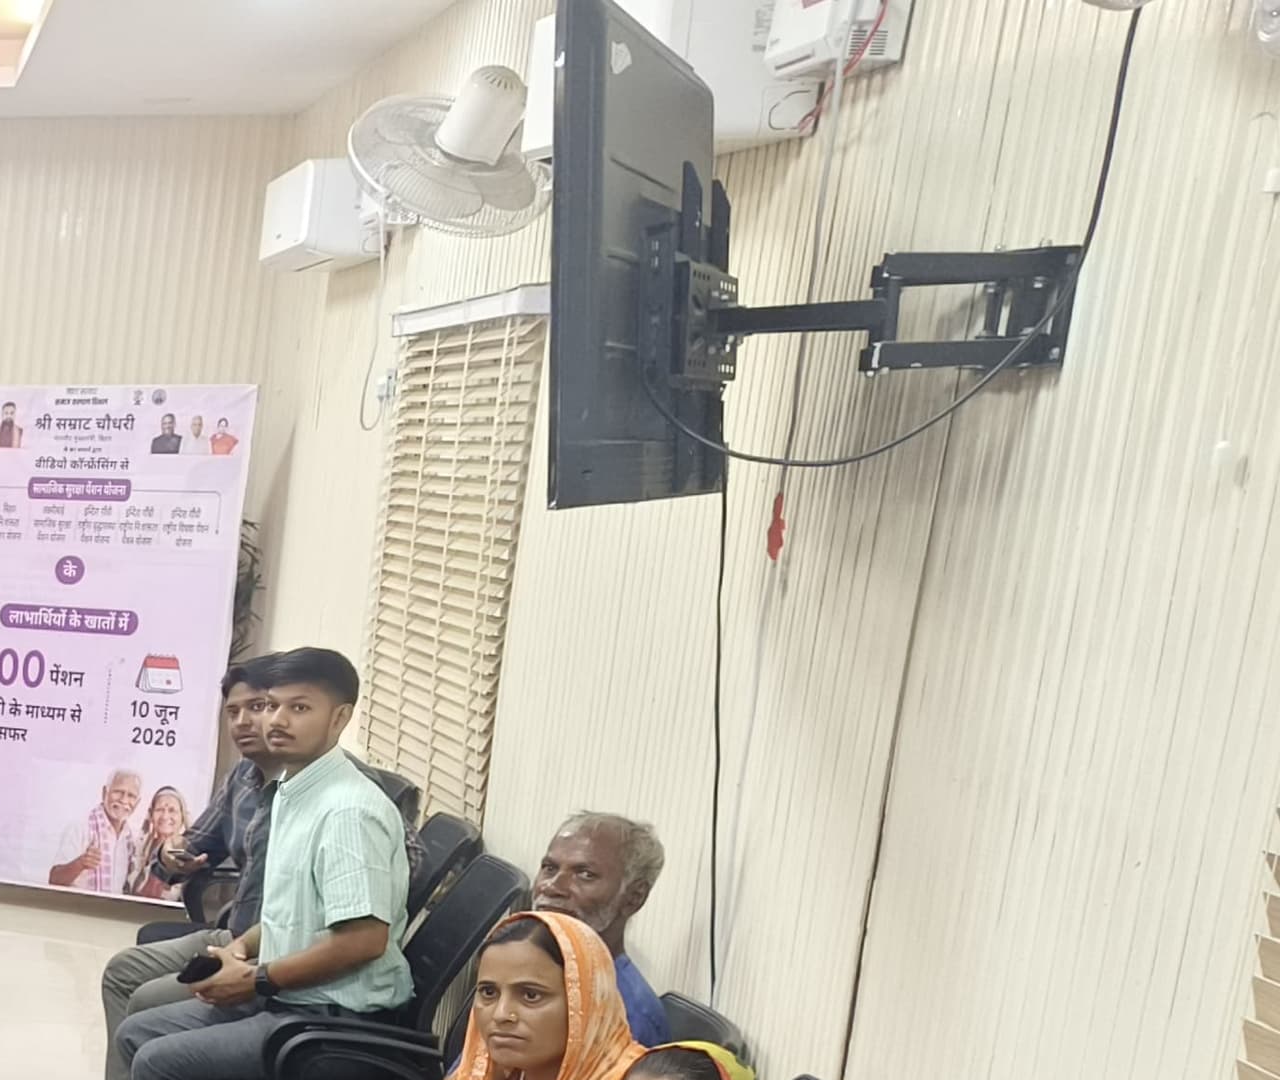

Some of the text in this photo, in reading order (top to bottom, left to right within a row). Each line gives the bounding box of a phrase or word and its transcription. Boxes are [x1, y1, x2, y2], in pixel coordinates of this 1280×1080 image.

[35, 413, 136, 431] श्री सम्राट चौधरी
[35, 456, 67, 469] वीडियो
[120, 457, 130, 470] से
[63, 562, 77, 578] के
[8, 607, 131, 631] लाभार्थियों के खातों में
[49, 664, 85, 687] पेंशन
[9, 699, 22, 716] के
[25, 704, 66, 722] माध्यम
[70, 703, 82, 723] से
[130, 700, 180, 725] 10 जून
[131, 726, 177, 747] 2026
